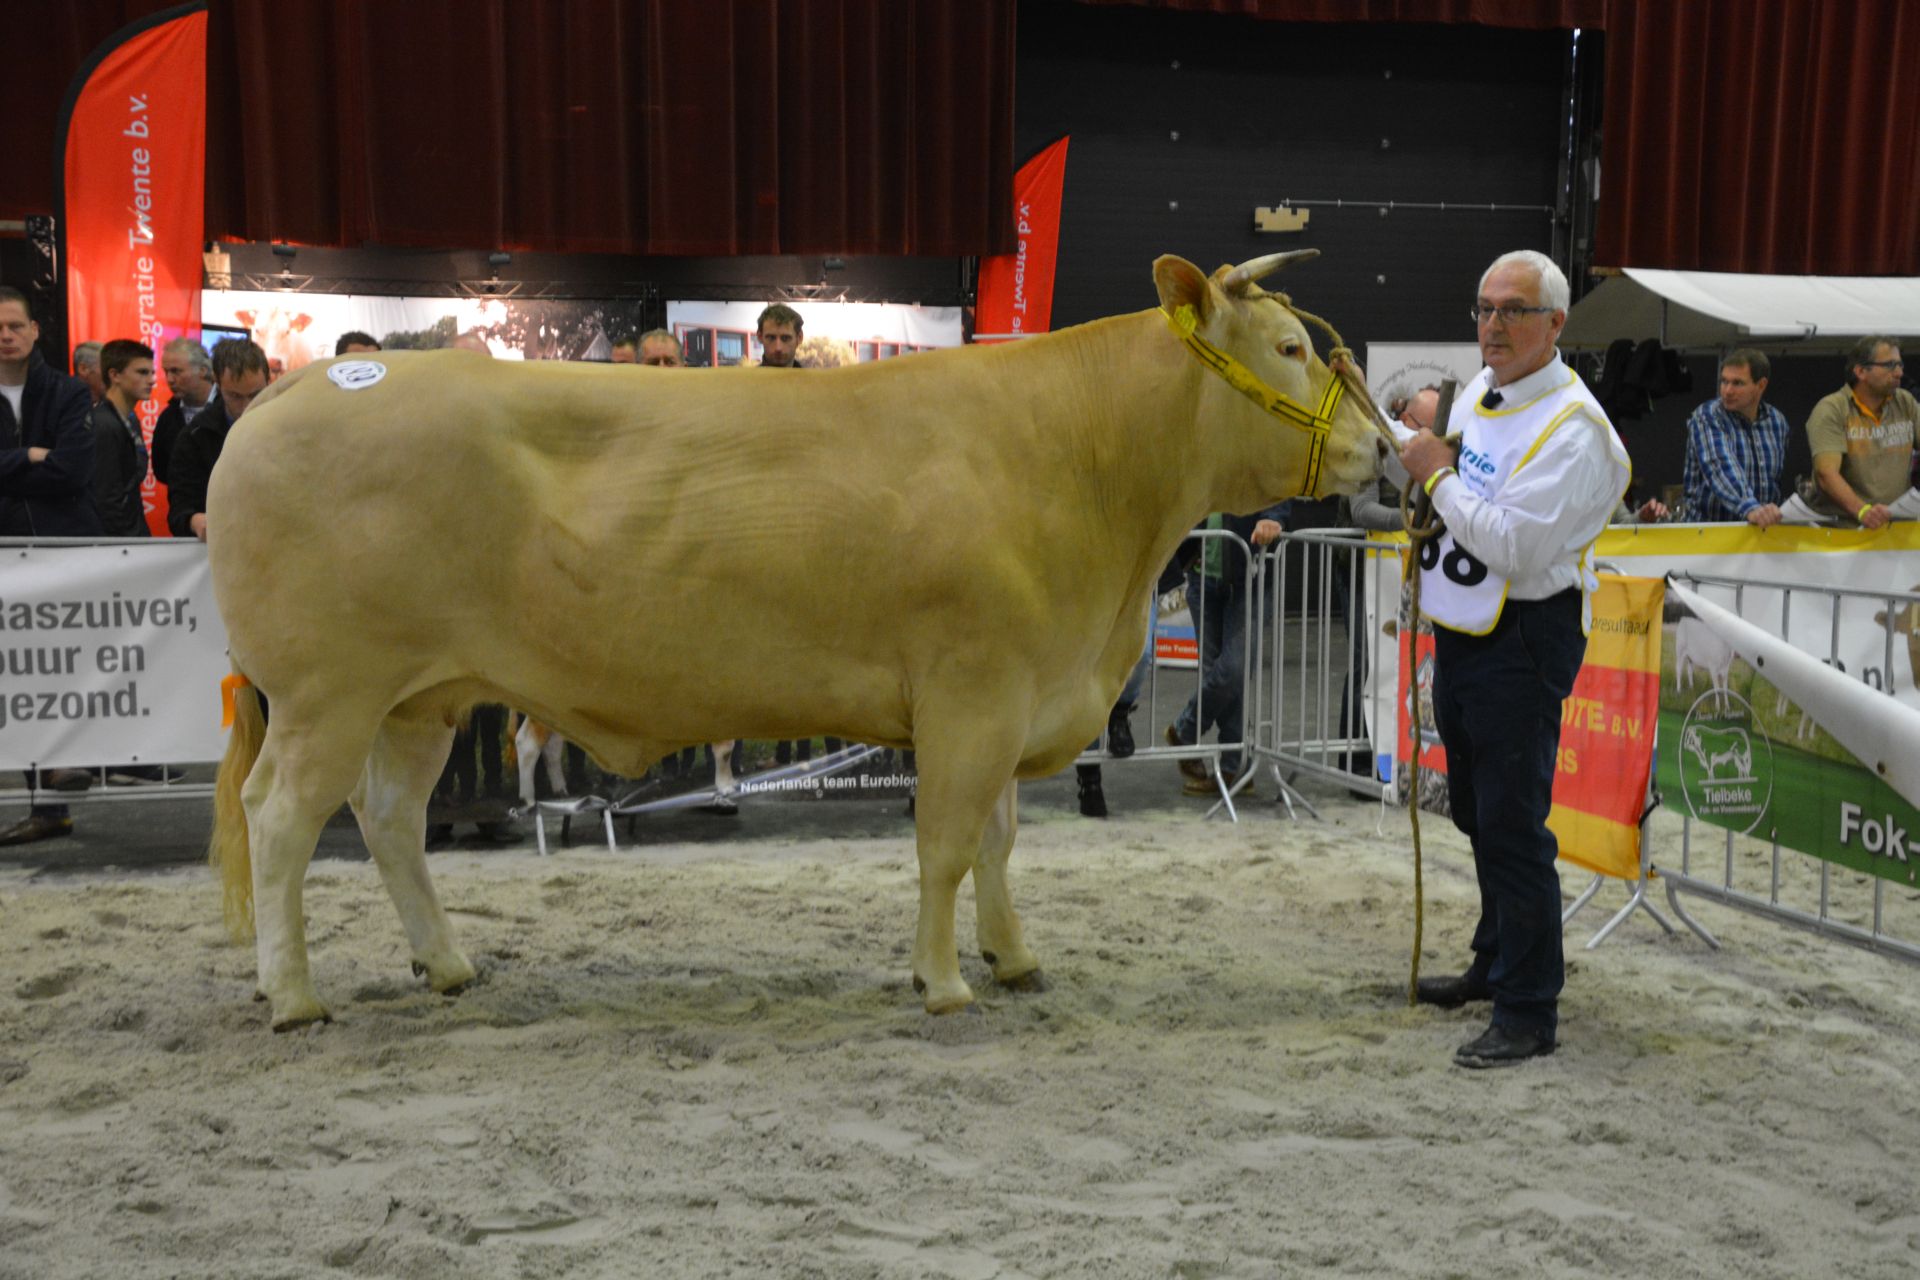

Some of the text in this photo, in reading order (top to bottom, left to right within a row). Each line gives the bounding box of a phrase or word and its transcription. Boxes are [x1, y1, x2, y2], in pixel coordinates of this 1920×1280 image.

[122, 92, 149, 139] b.v.
[127, 147, 154, 251] Twente
[0, 591, 197, 632] aszuiver,
[0, 643, 146, 676] uur en
[0, 680, 151, 730] ezond.
[1611, 713, 1643, 740] B.V.
[740, 776, 820, 794] Nederlands
[823, 775, 857, 789] team
[1703, 786, 1752, 804] Tielbeke
[1840, 800, 1920, 862] Fok-
